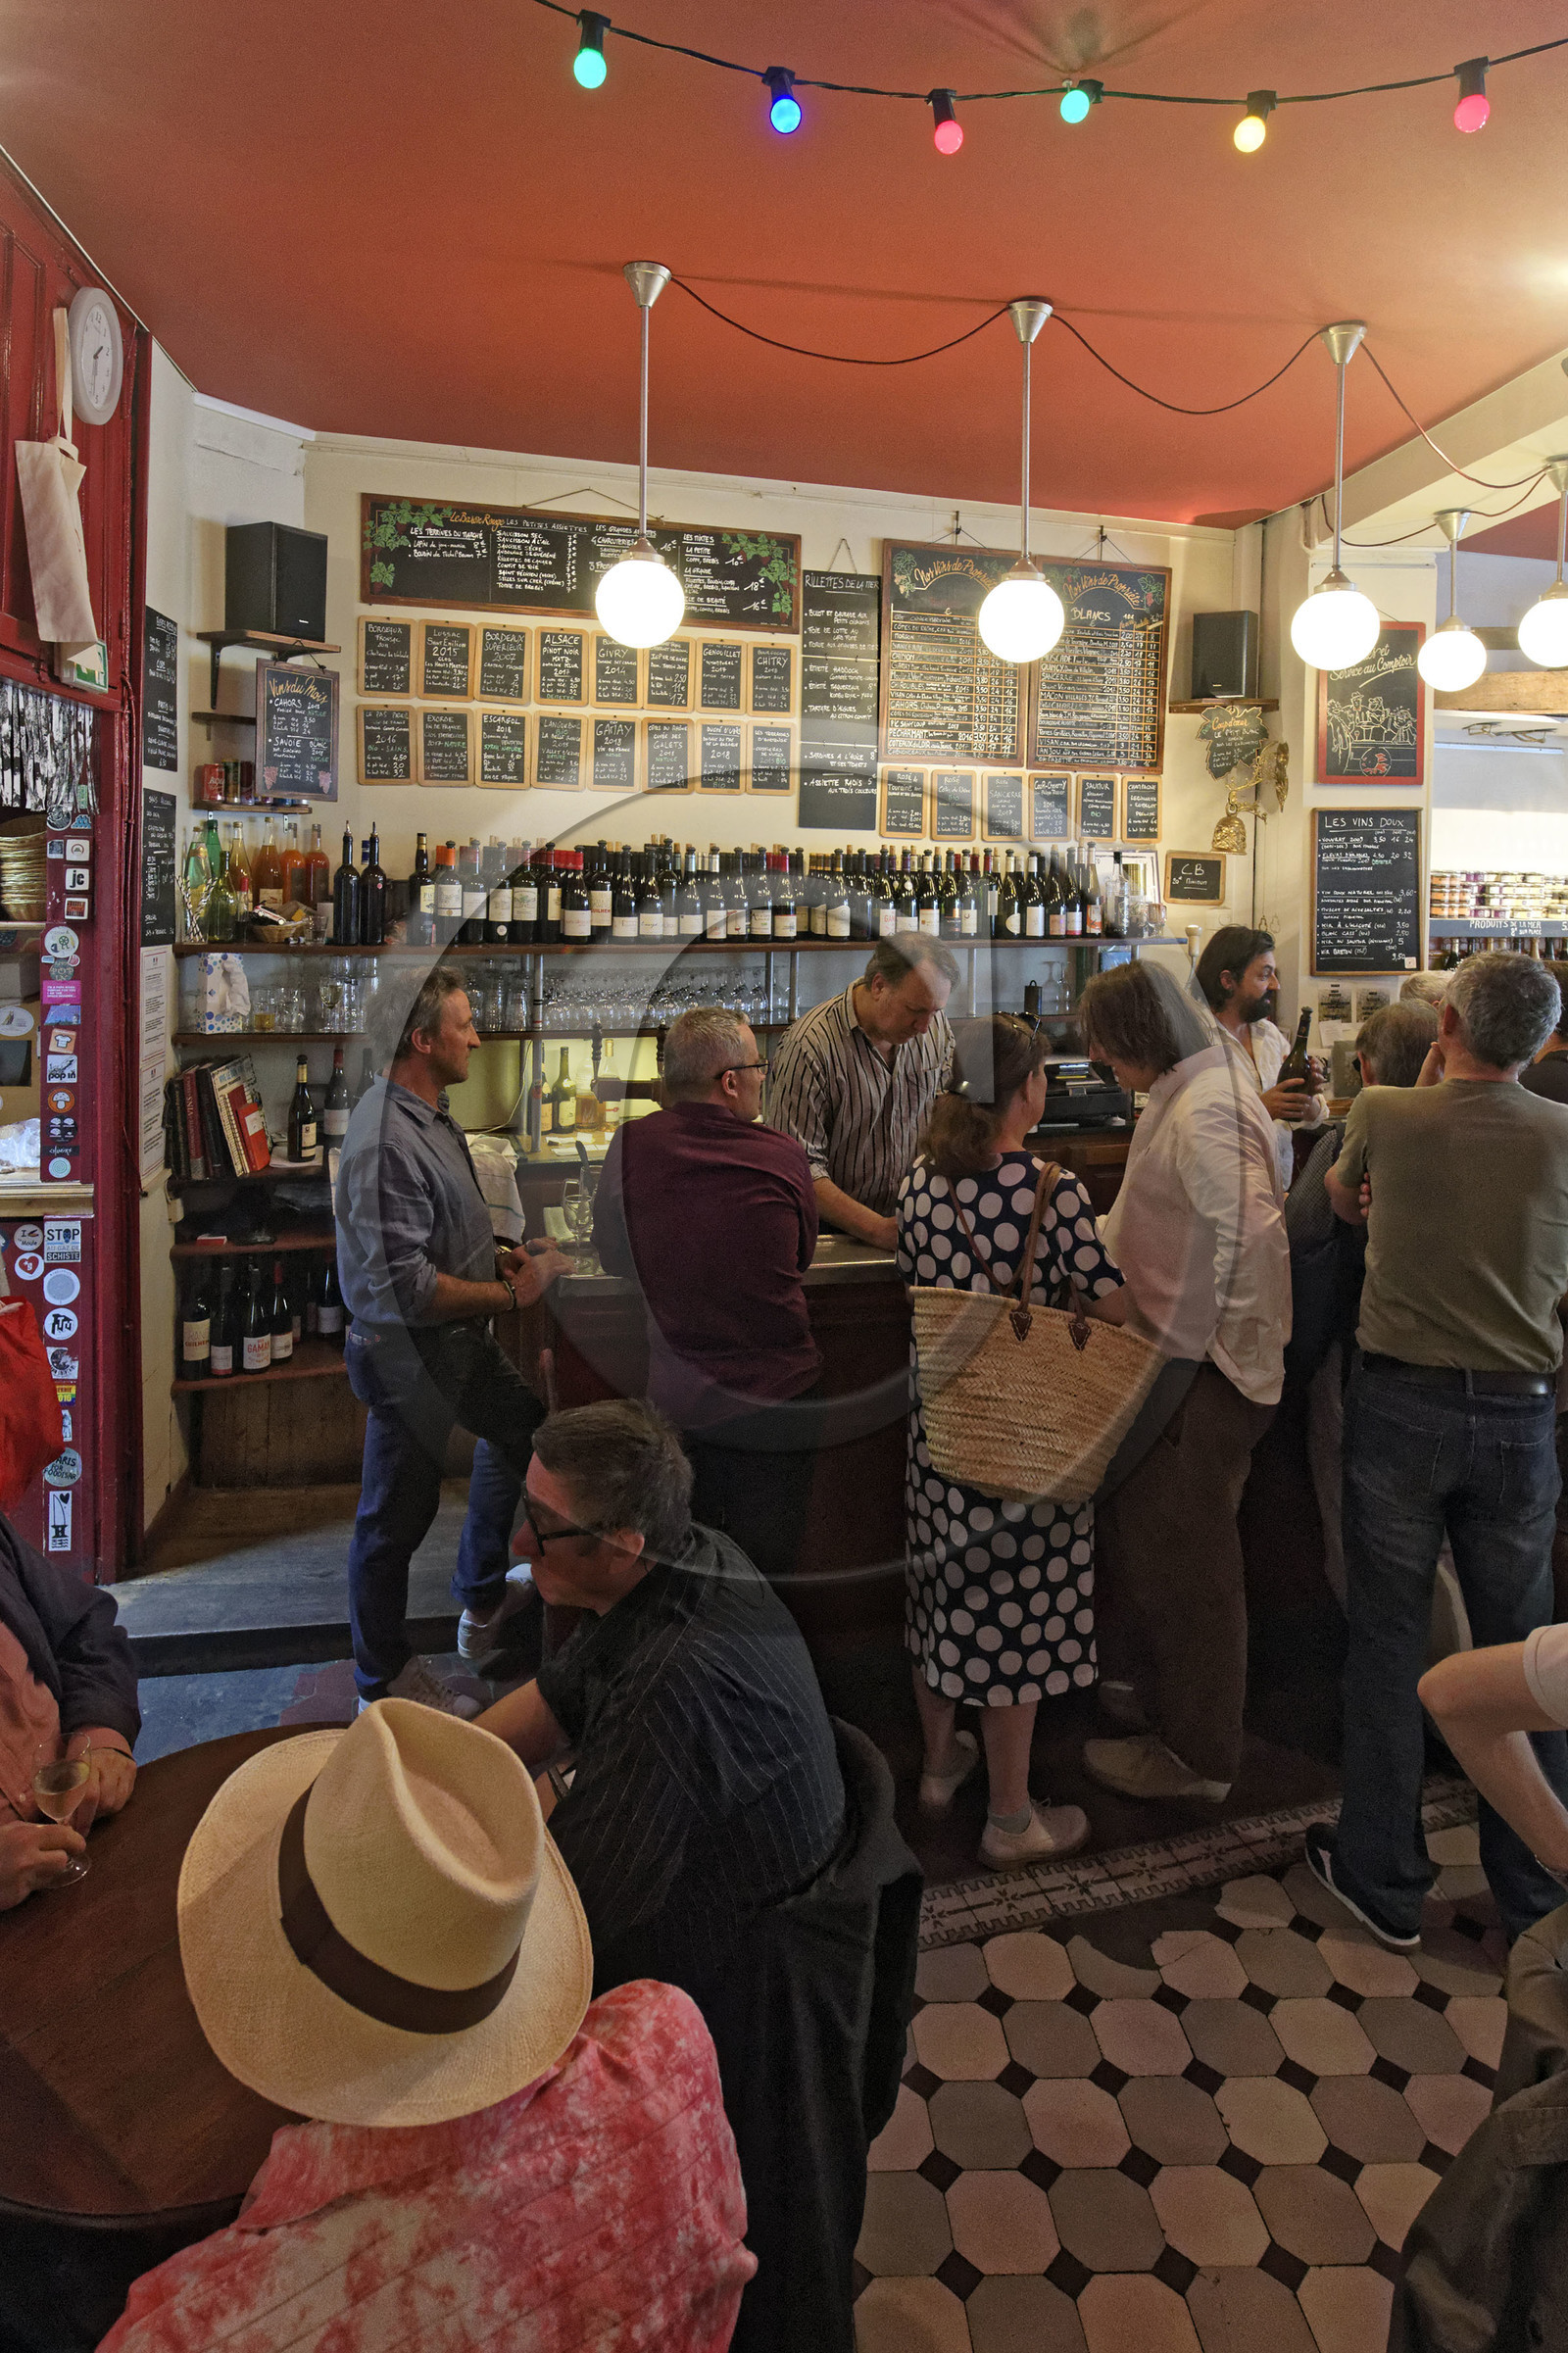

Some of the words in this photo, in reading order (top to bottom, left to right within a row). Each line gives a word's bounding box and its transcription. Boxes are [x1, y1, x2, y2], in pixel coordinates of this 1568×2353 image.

[410, 527, 423, 536] LES
[522, 520, 548, 529] PETITES
[551, 523, 588, 533] ASSIETTES
[496, 530, 529, 539] SAUCISSON
[914, 567, 934, 587] Nos
[933, 560, 953, 576] Vins
[952, 557, 964, 571] de
[1098, 572, 1109, 586] de
[845, 579, 856, 588] DE
[856, 580, 864, 591] LA
[1070, 607, 1111, 622] BLANCS
[368, 623, 403, 635] BORDEAUX
[433, 629, 461, 638] LUSSAC
[485, 631, 525, 644] BORDEAUX
[544, 635, 580, 644] ALSACE
[432, 646, 460, 657] 2015
[542, 647, 562, 656] PINOT
[598, 648, 629, 659] GIVRY
[703, 648, 741, 659] GENOUILLET
[891, 651, 915, 661] CHINON
[492, 652, 516, 663] 2007
[756, 656, 788, 668] CHITRY
[604, 666, 627, 676] 2014
[1329, 667, 1364, 681] Service
[1363, 663, 1376, 674] au
[1376, 653, 1417, 673] Comptoir
[1041, 672, 1073, 681] SANCERRE
[269, 678, 290, 698] Vins
[290, 677, 305, 693] du
[303, 675, 329, 705] Mois
[274, 698, 302, 709] CAHORS
[427, 714, 455, 723] EXORDE
[595, 724, 632, 737] GAMAY
[274, 736, 301, 748] SAVOIE
[375, 735, 397, 744] 2016
[604, 737, 622, 746] 2018
[653, 740, 683, 750] GALETS
[710, 749, 731, 760] 2018
[809, 777, 840, 787] ASSIETTE
[844, 778, 863, 787] RADIS
[944, 775, 960, 784] ROSÉ
[1084, 782, 1110, 791] SAUMUR
[1324, 816, 1347, 828] LES
[1352, 817, 1374, 828] VINS
[1379, 817, 1404, 828] DOUX
[1180, 863, 1205, 877] CB
[1470, 920, 1509, 929] PRODUITS
[1527, 921, 1542, 929] MER
[1397, 937, 1404, 946] 5
[48, 1072, 67, 1081] pop
[47, 1251, 80, 1261] SCHISTE
[55, 1455, 76, 1467] ARIS
